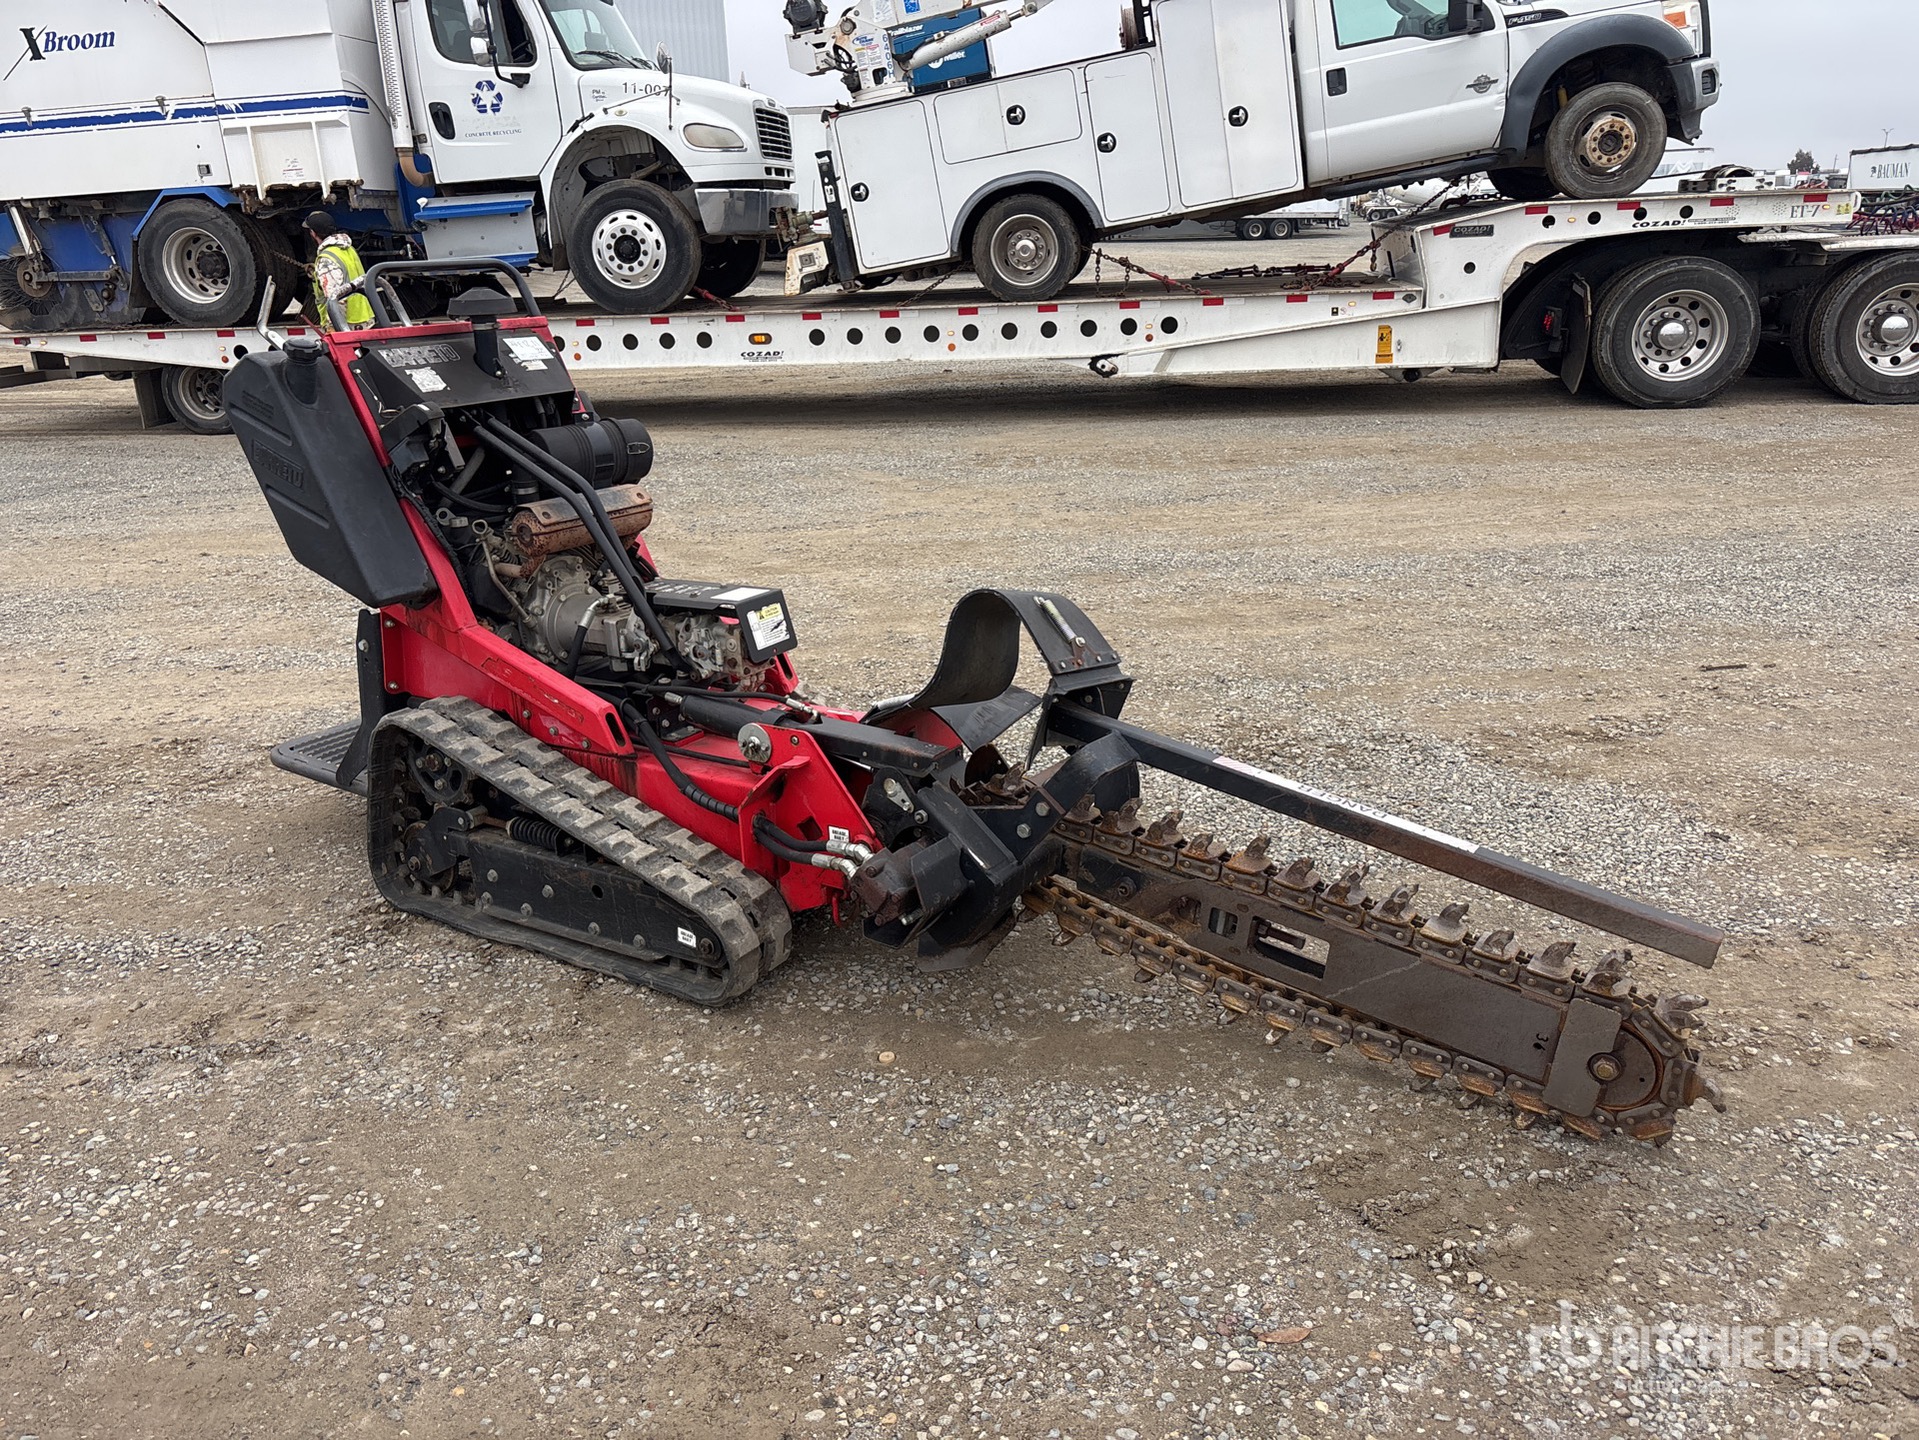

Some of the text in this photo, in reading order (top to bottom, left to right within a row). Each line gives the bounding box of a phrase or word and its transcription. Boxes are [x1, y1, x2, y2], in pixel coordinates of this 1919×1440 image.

[10, 25, 115, 67] XBroom
[882, 34, 896, 78] 6406H
[622, 81, 671, 97] 11-007
[492, 128, 522, 136] RECYCLING
[1877, 162, 1911, 179] BAUMAN
[1790, 204, 1821, 218] ET-7
[1454, 225, 1491, 233] COZAD!
[1632, 219, 1686, 229] COZAD!
[377, 343, 461, 368] BARRETO
[740, 350, 785, 358] COZAD!
